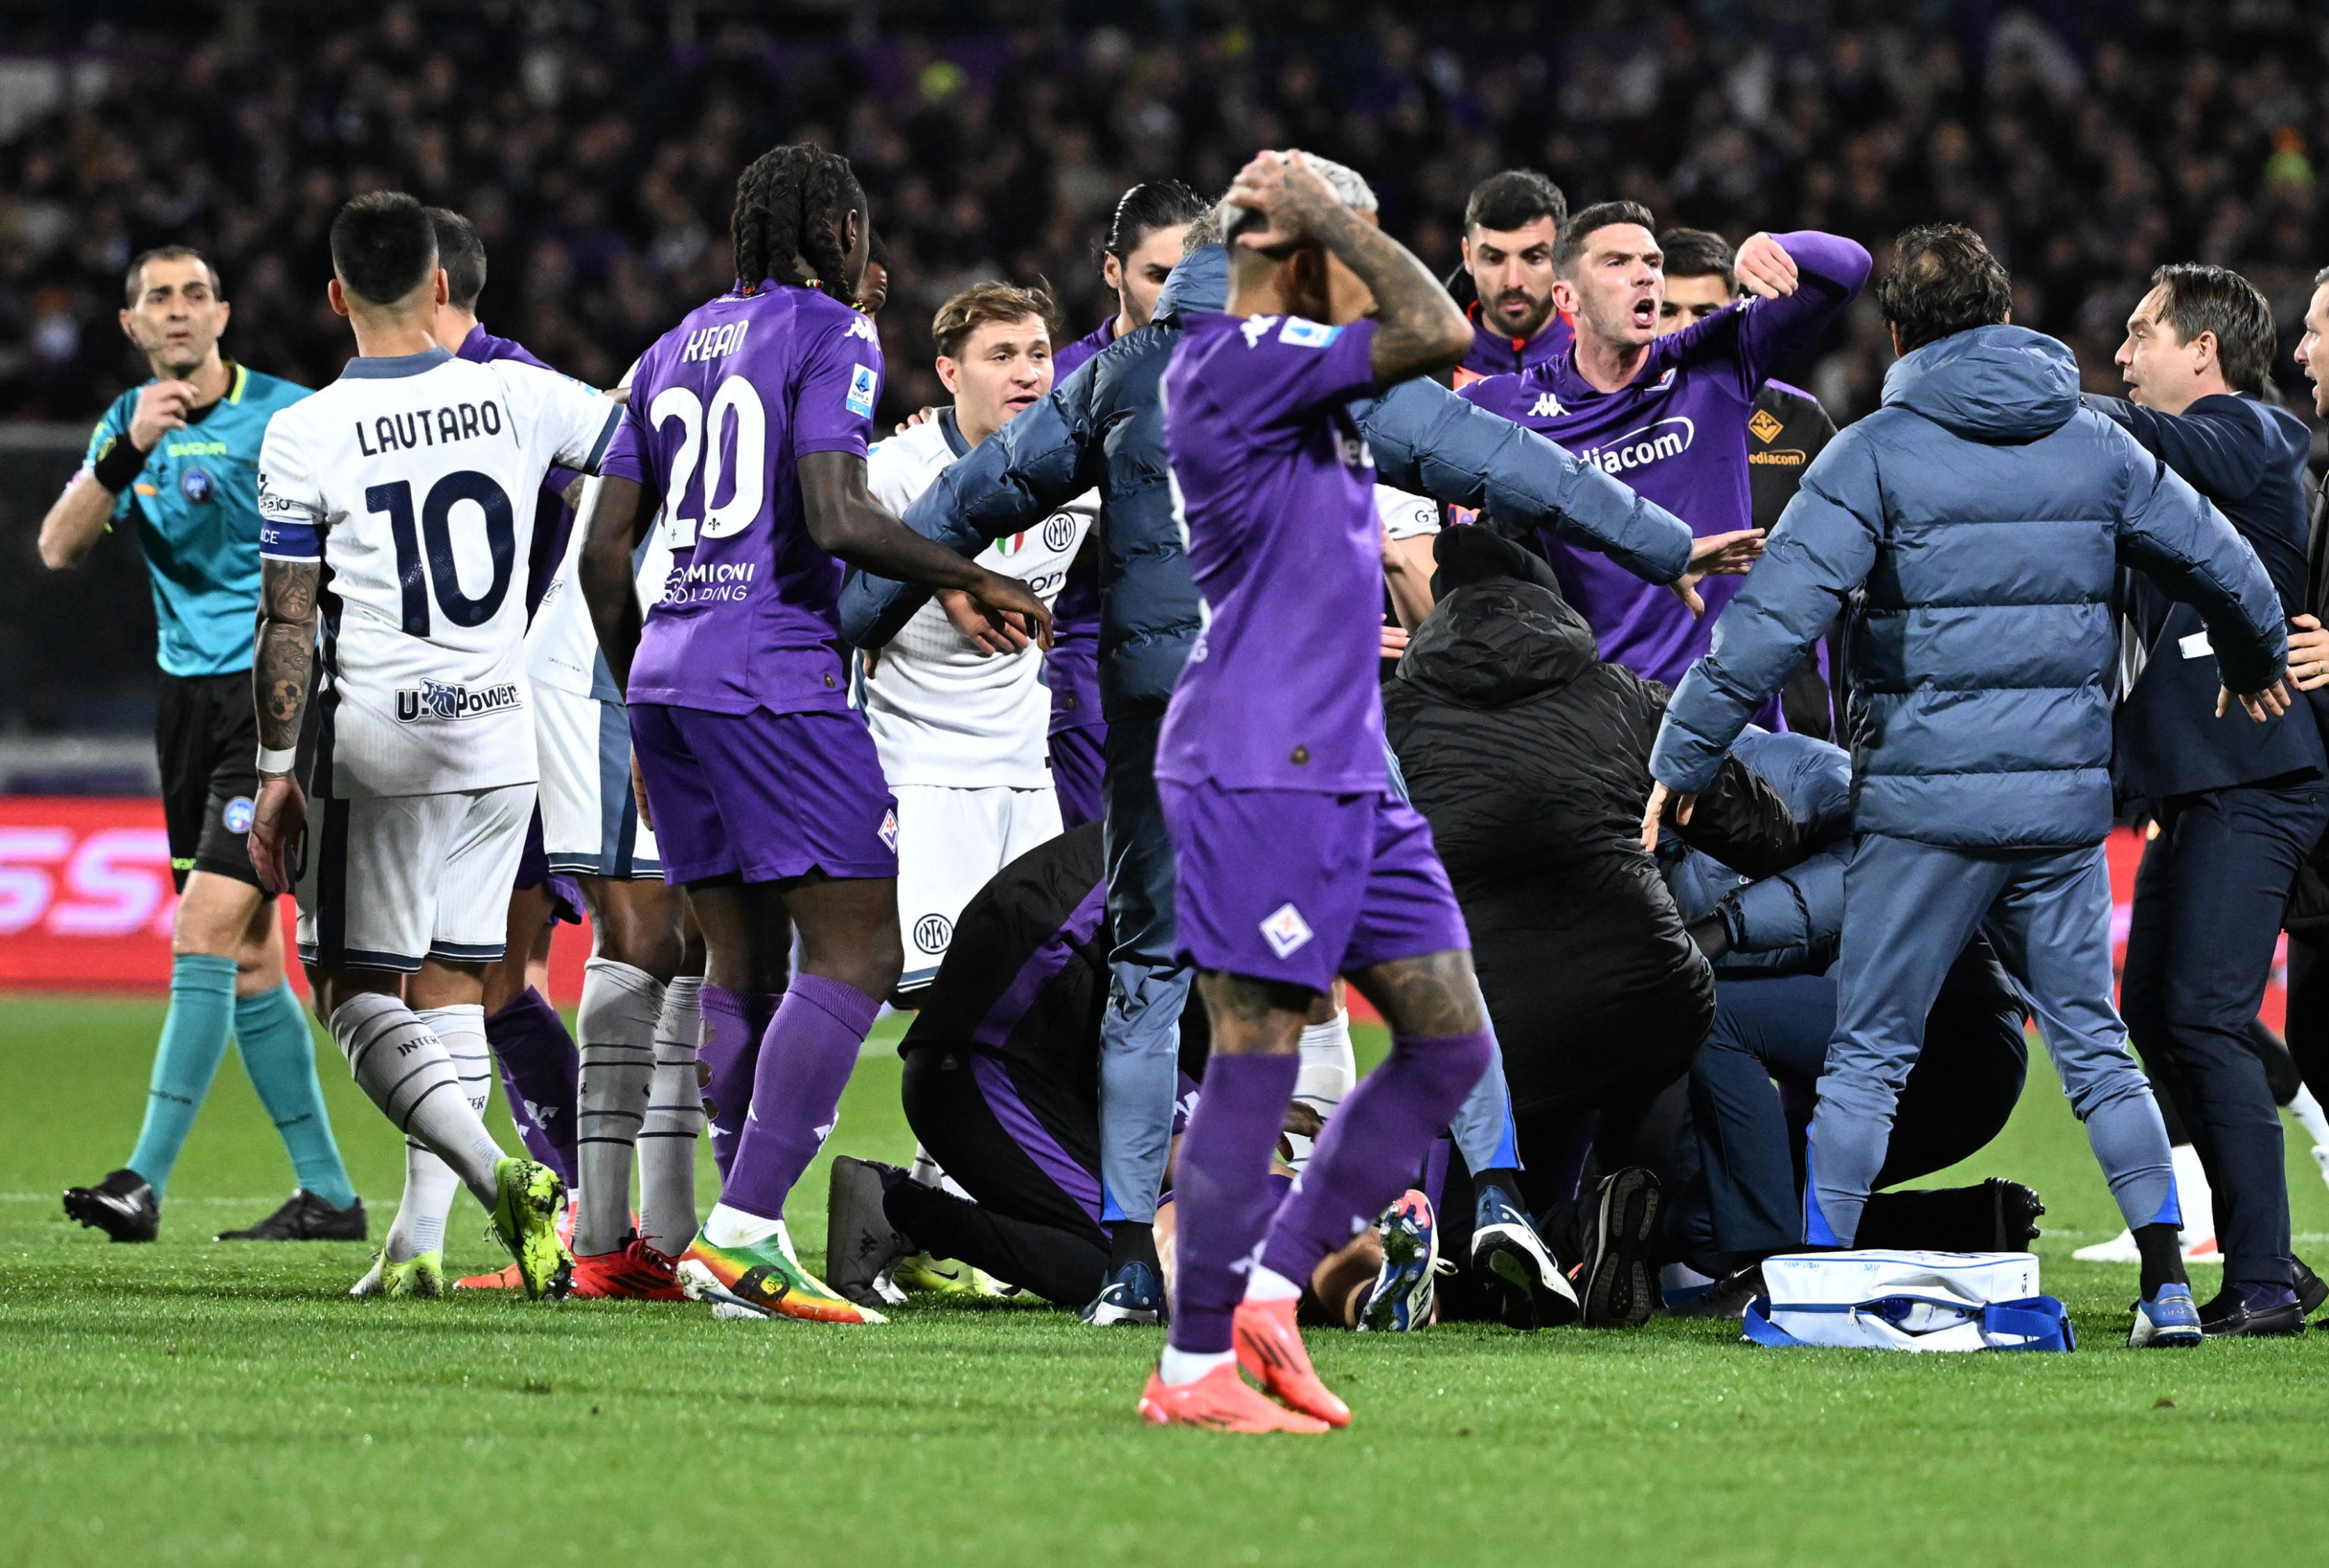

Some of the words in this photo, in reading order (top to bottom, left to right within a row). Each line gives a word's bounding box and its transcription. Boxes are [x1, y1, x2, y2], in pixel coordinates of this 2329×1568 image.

[682, 319, 749, 363] KEAN
[355, 400, 501, 457] LAUTARO
[650, 375, 765, 551] 20
[365, 470, 515, 637] 10
[397, 1036, 440, 1057] INTER
